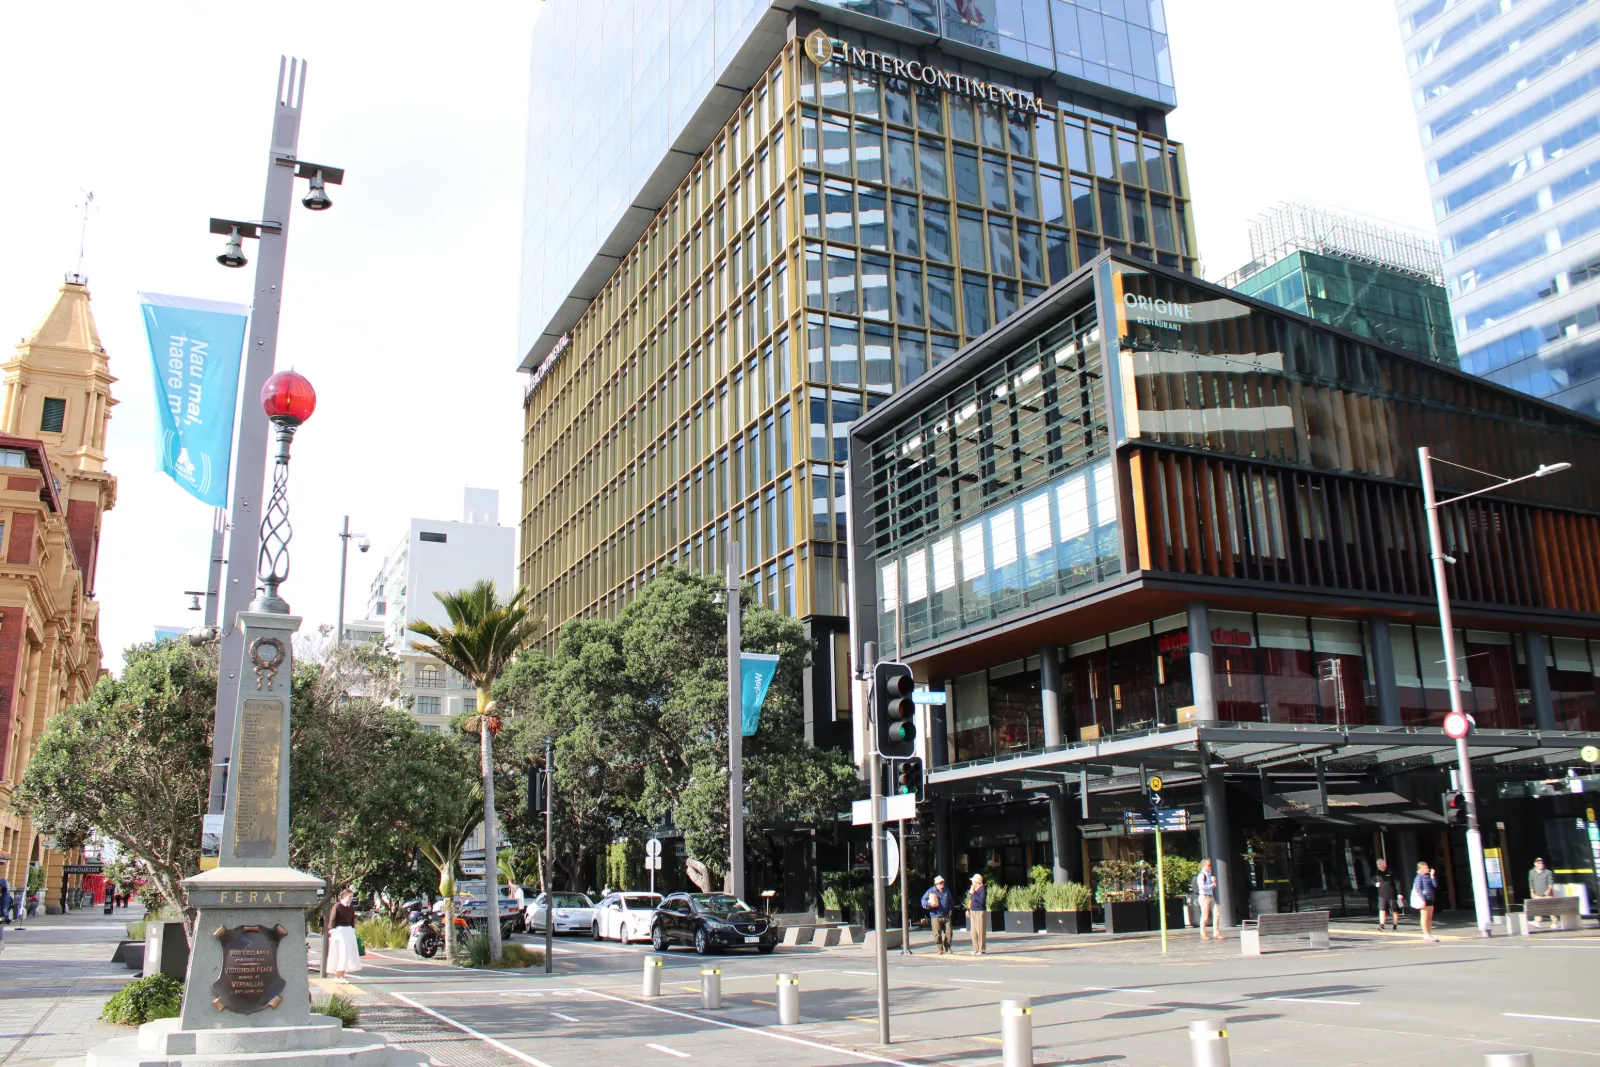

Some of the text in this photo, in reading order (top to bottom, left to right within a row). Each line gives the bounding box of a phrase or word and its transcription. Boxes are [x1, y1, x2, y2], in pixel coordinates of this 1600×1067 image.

[842, 42, 1048, 115] INTERCONTINENTAL
[1123, 292, 1194, 320] ORIGINE
[1137, 316, 1182, 332] RESTAURANT
[168, 335, 189, 390] haere
[183, 338, 209, 426] Nau mai,
[220, 891, 286, 903] FERAT
[224, 965, 273, 975] VICTORIOUS PEACE
